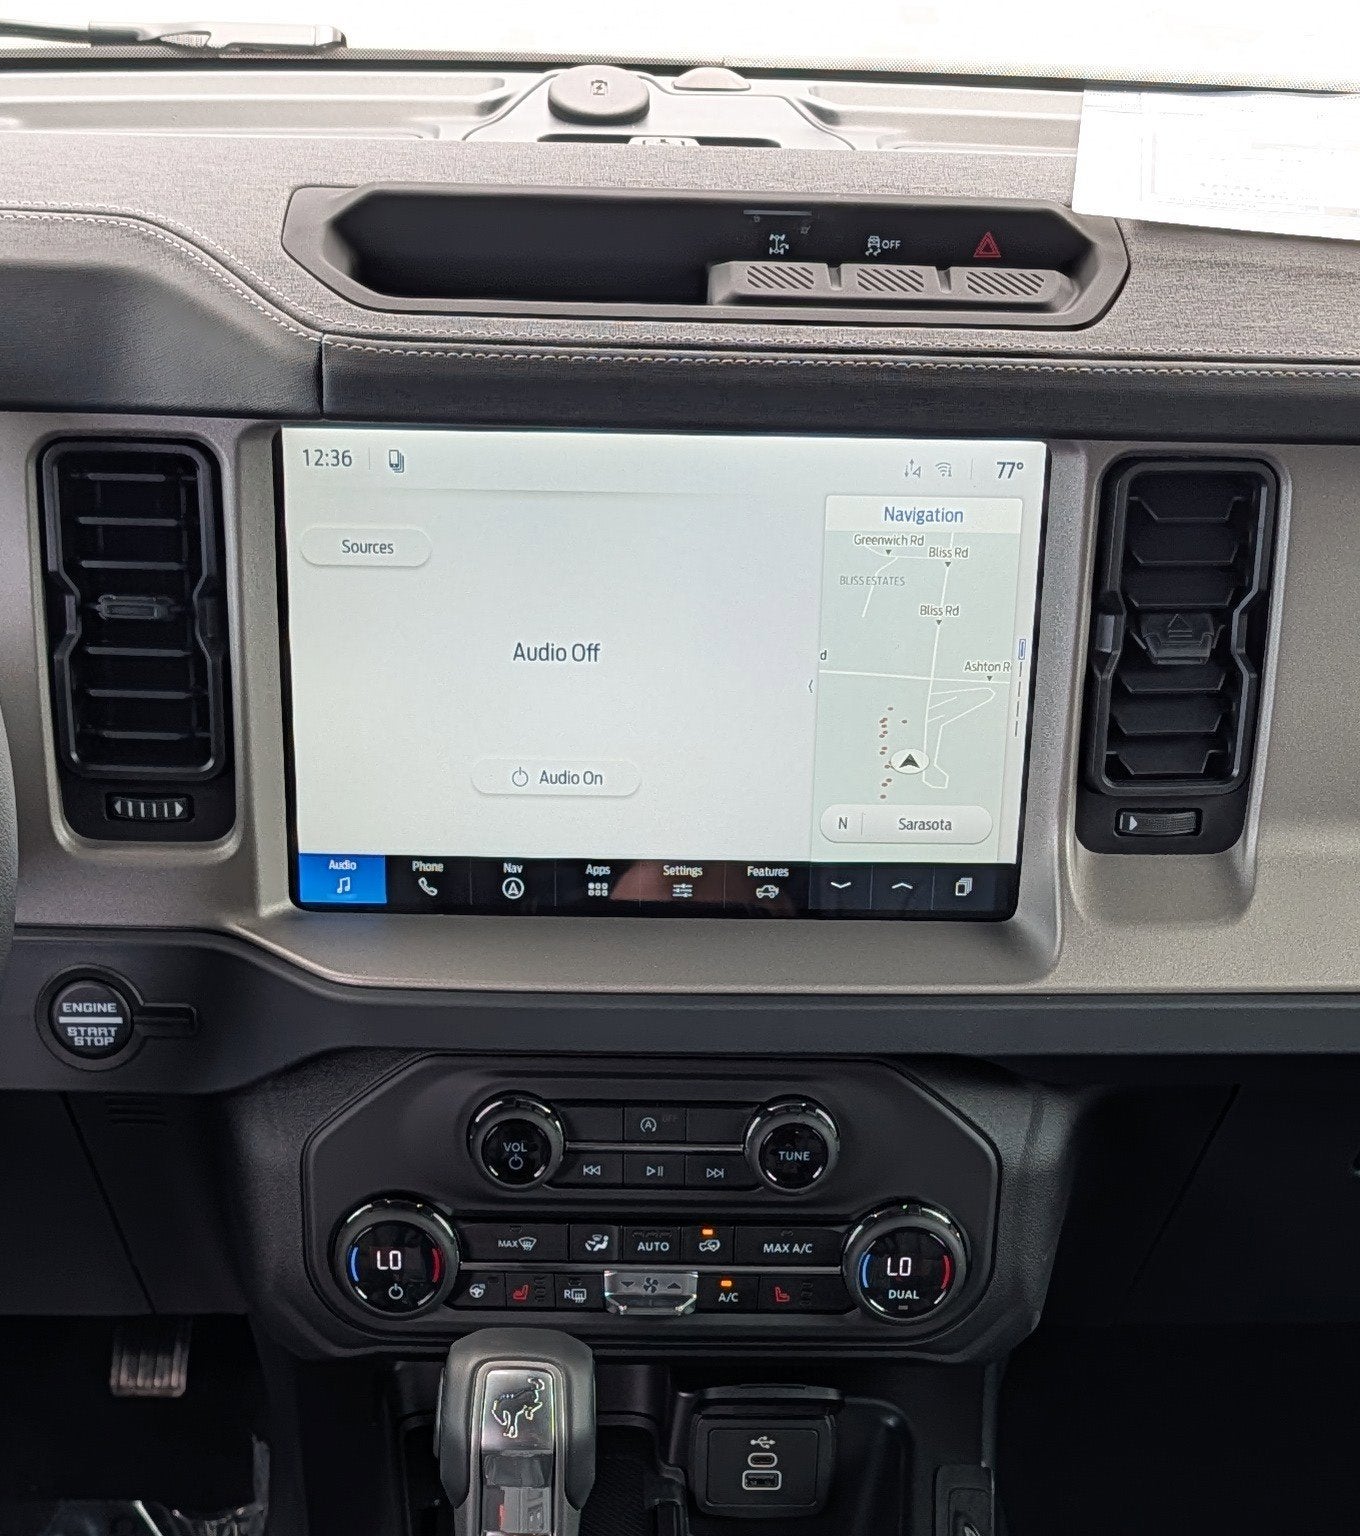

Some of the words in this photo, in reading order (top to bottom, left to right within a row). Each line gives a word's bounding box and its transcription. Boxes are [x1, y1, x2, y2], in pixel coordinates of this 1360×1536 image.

[882, 239, 901, 250] OFF
[302, 449, 352, 467] 12:36
[996, 461, 1024, 479] 77°
[884, 507, 964, 525] Navigation
[854, 534, 907, 546] Greenwich
[910, 535, 924, 546] Rd
[342, 539, 394, 555] Sources
[929, 547, 952, 558] Bliss
[955, 547, 968, 558] Rd
[840, 576, 864, 586] BLISS
[866, 576, 905, 586] ESTATES
[920, 605, 943, 616] Bliss
[945, 605, 959, 616] Rd
[513, 642, 567, 661] Audio
[572, 643, 600, 662] Off
[964, 661, 1000, 672] Ashton
[1003, 662, 1012, 672] R
[540, 770, 580, 785] Audio
[583, 771, 603, 785] On
[838, 817, 848, 829] N
[898, 818, 952, 831] Sarasota
[329, 860, 357, 871] Audio
[412, 861, 443, 872] Phone
[503, 862, 523, 873] Nav
[586, 864, 611, 876] Apps
[663, 865, 703, 878] Settings
[747, 866, 789, 878] Features
[62, 1002, 117, 1013] ENGINE
[67, 1026, 118, 1037] START
[74, 1036, 114, 1046] STOP
[503, 1142, 528, 1152] VOL
[779, 1151, 810, 1162] TUNE
[498, 1240, 519, 1248] MAX
[637, 1242, 670, 1251] AUTO
[763, 1243, 790, 1253] MAX
[792, 1243, 812, 1254] A/C
[377, 1250, 401, 1270] LO
[887, 1257, 912, 1277] LO
[719, 1293, 738, 1302] A/C
[889, 1290, 920, 1300] DUAL
